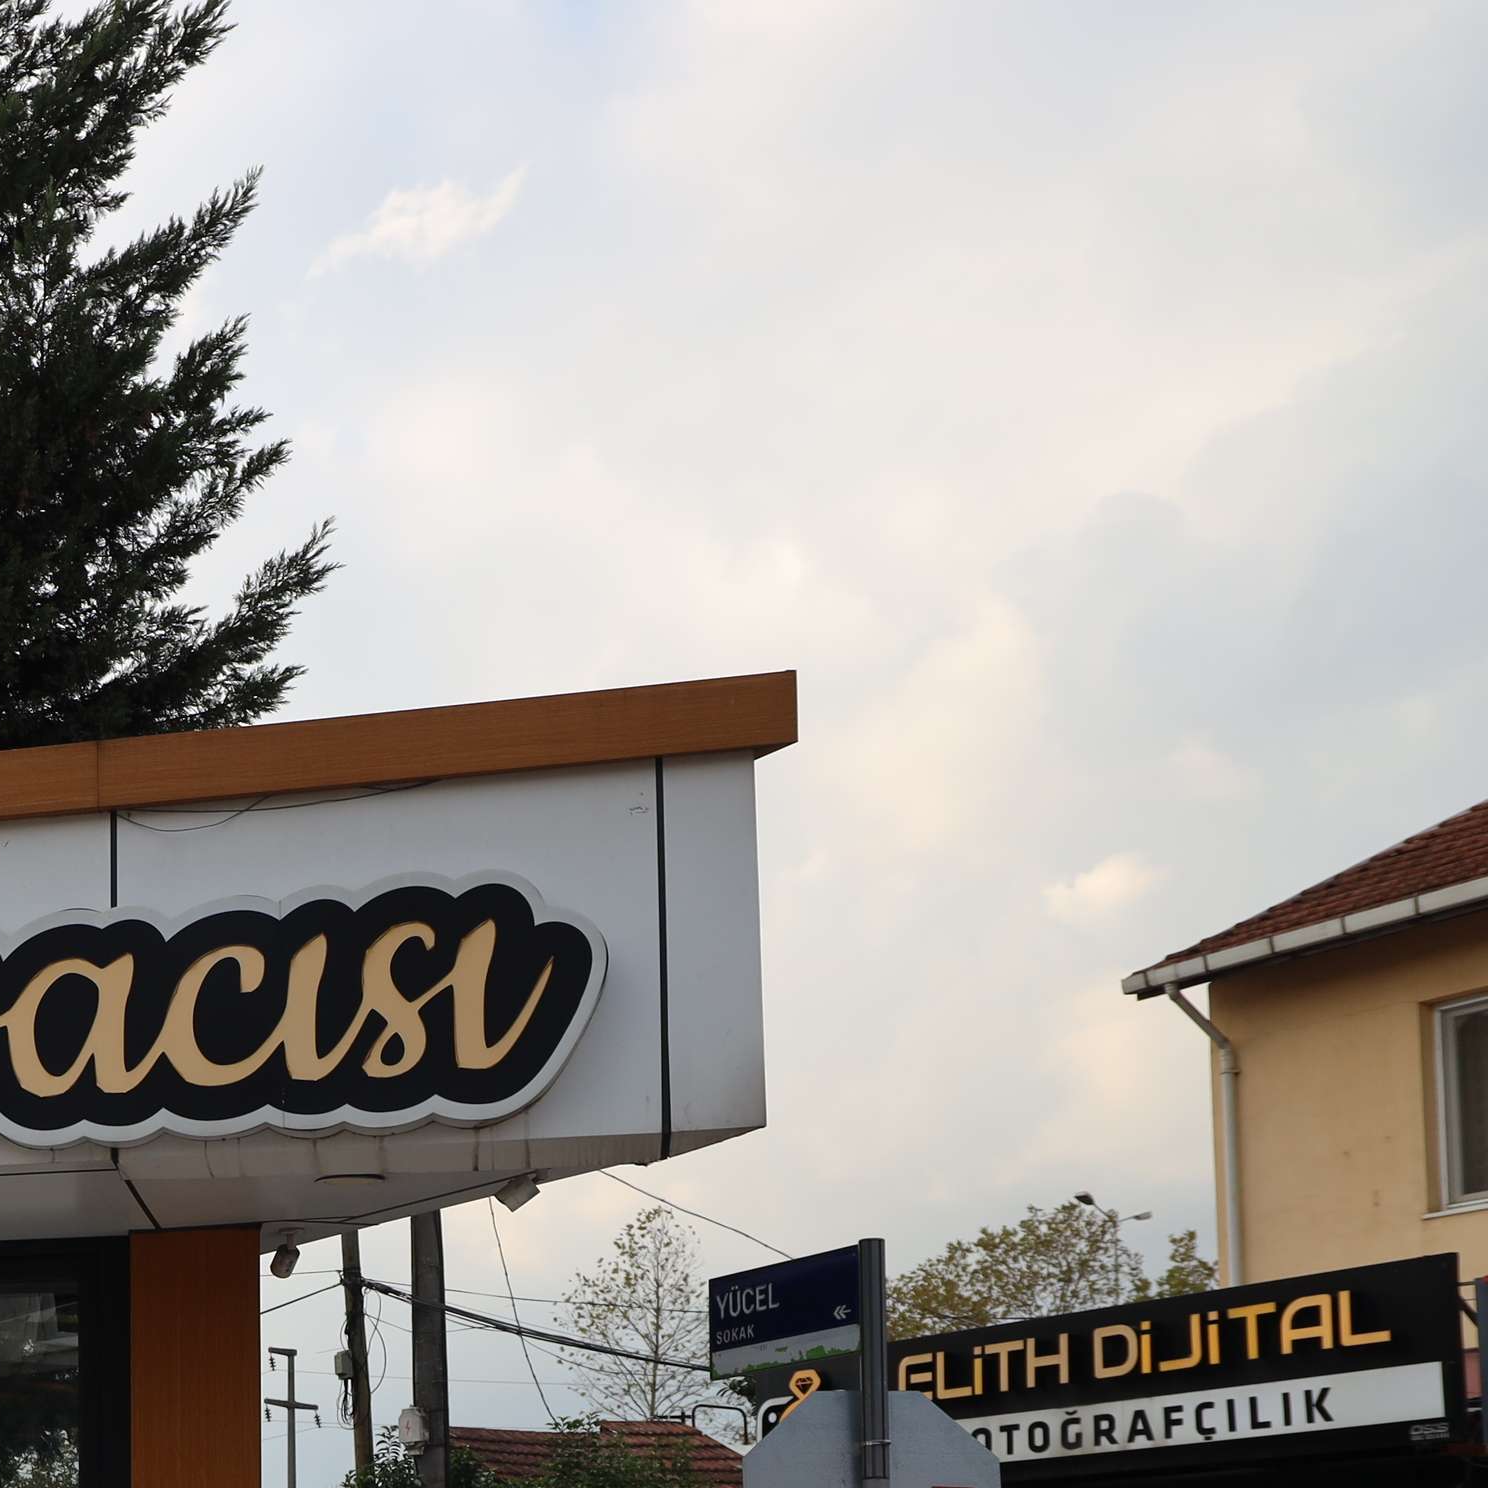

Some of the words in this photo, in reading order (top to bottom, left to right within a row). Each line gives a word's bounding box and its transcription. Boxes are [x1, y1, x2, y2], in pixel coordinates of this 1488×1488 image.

[716, 1282, 781, 1320] YÜCEL
[716, 1324, 755, 1345] SOKAK
[970, 1387, 1335, 1456] OTOĞRAFÇILIK
